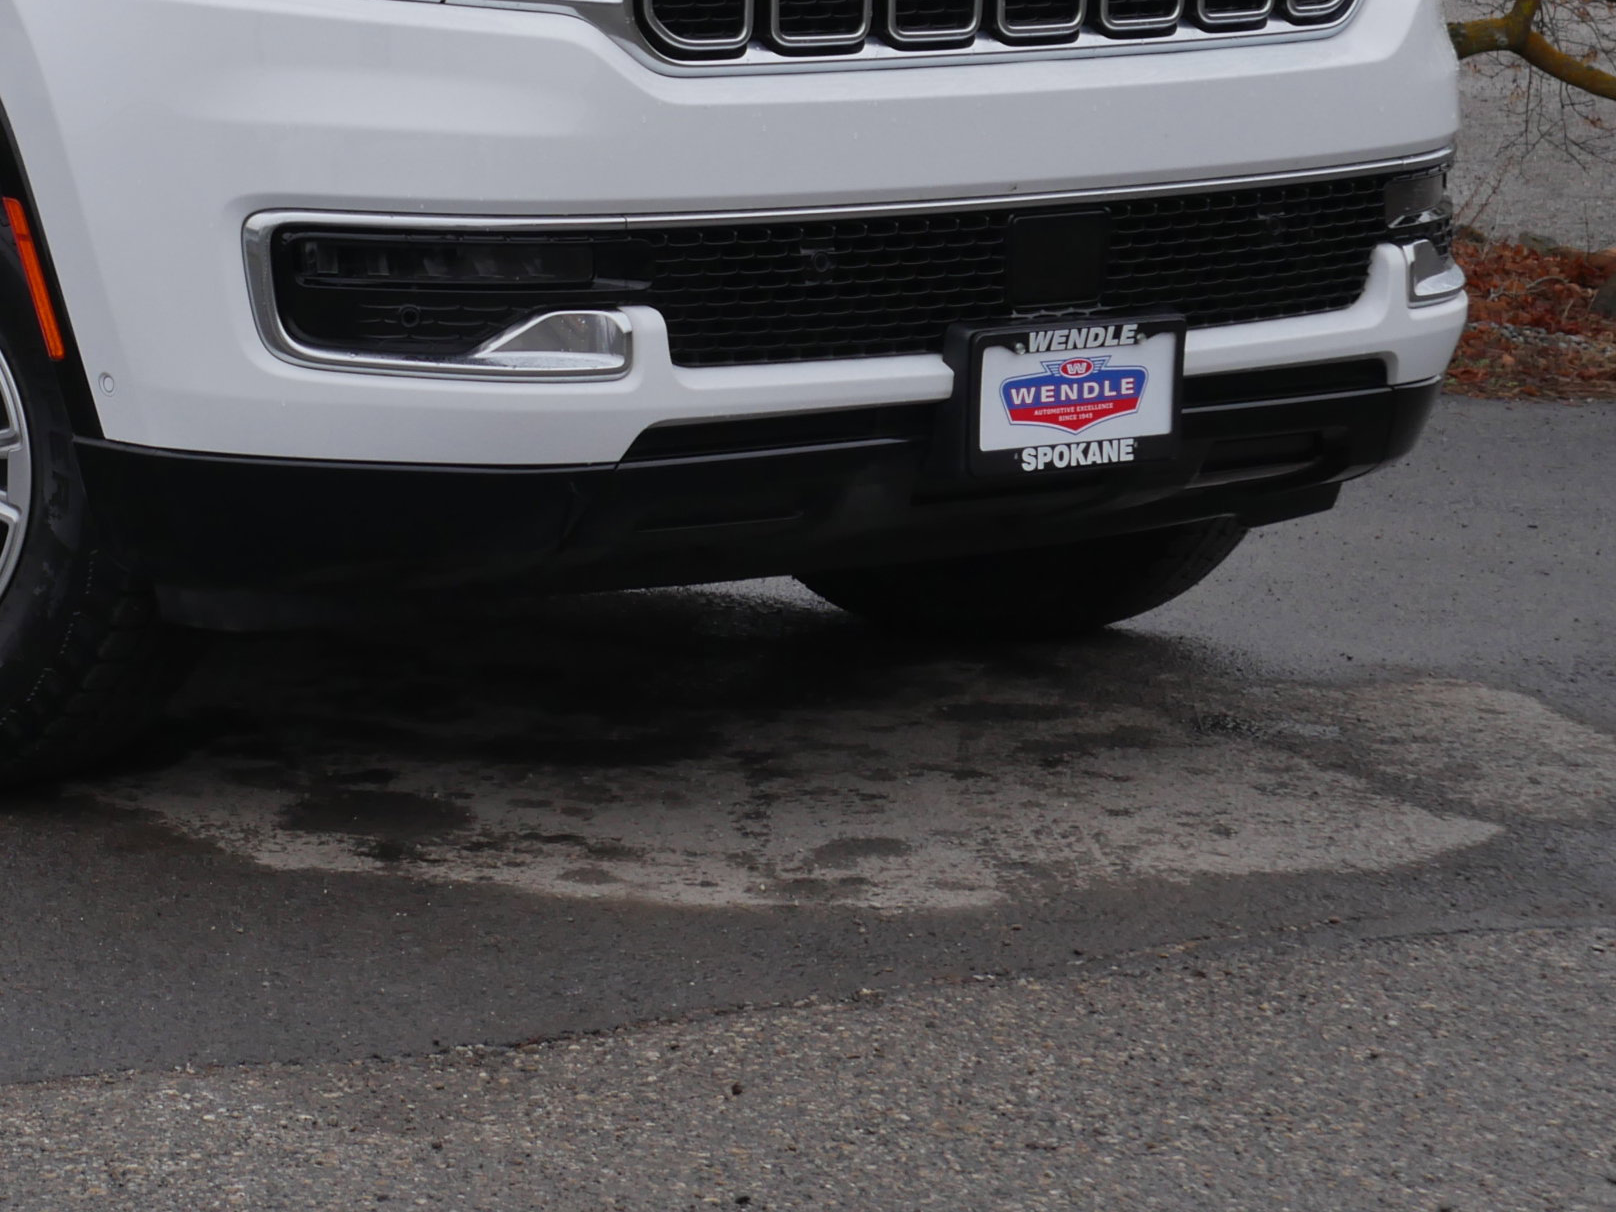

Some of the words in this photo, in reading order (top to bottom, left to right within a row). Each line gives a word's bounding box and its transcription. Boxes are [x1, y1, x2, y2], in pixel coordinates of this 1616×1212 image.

[1028, 324, 1138, 353] WENDLE
[1010, 378, 1134, 405] WENDLE
[1034, 406, 1075, 416] AUTOMOTIVE
[1076, 402, 1114, 412] EXCELLENCE
[1058, 414, 1077, 422] SINCE
[1021, 439, 1134, 472] SPOKANE
